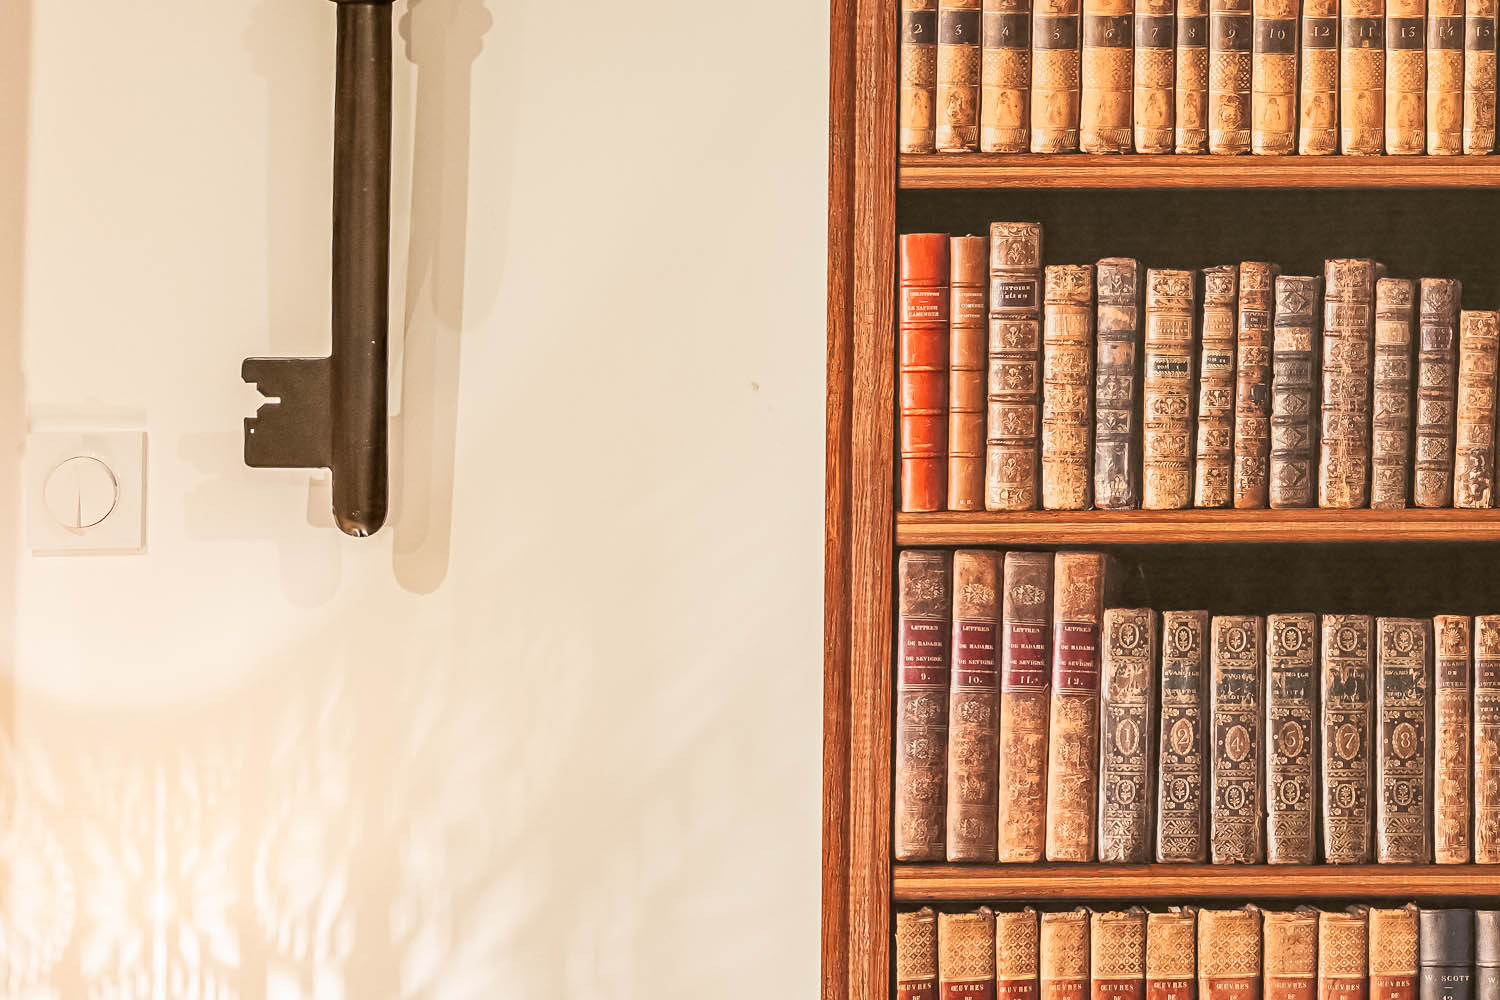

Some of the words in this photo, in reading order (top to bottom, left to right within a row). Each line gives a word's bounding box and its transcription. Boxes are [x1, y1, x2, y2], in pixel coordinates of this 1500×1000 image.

[913, 24, 923, 34] 2
[954, 24, 962, 35] 3
[1151, 27, 1159, 38] 7
[1188, 27, 1196, 38] 8
[1313, 26, 1330, 38] 12
[1123, 727, 1130, 744] 1
[1177, 727, 1190, 746] 2
[1342, 731, 1357, 750] 7
[1400, 731, 1411, 749] 8
[1230, 735, 1244, 753] 4
[1441, 974, 1470, 982] SCOTT
[951, 984, 985, 992] ŒUVRES
[1100, 984, 1135, 992] ŒUVRES
[1153, 981, 1188, 990] ŒUVRES
[1215, 982, 1250, 990] ŒUVRES
